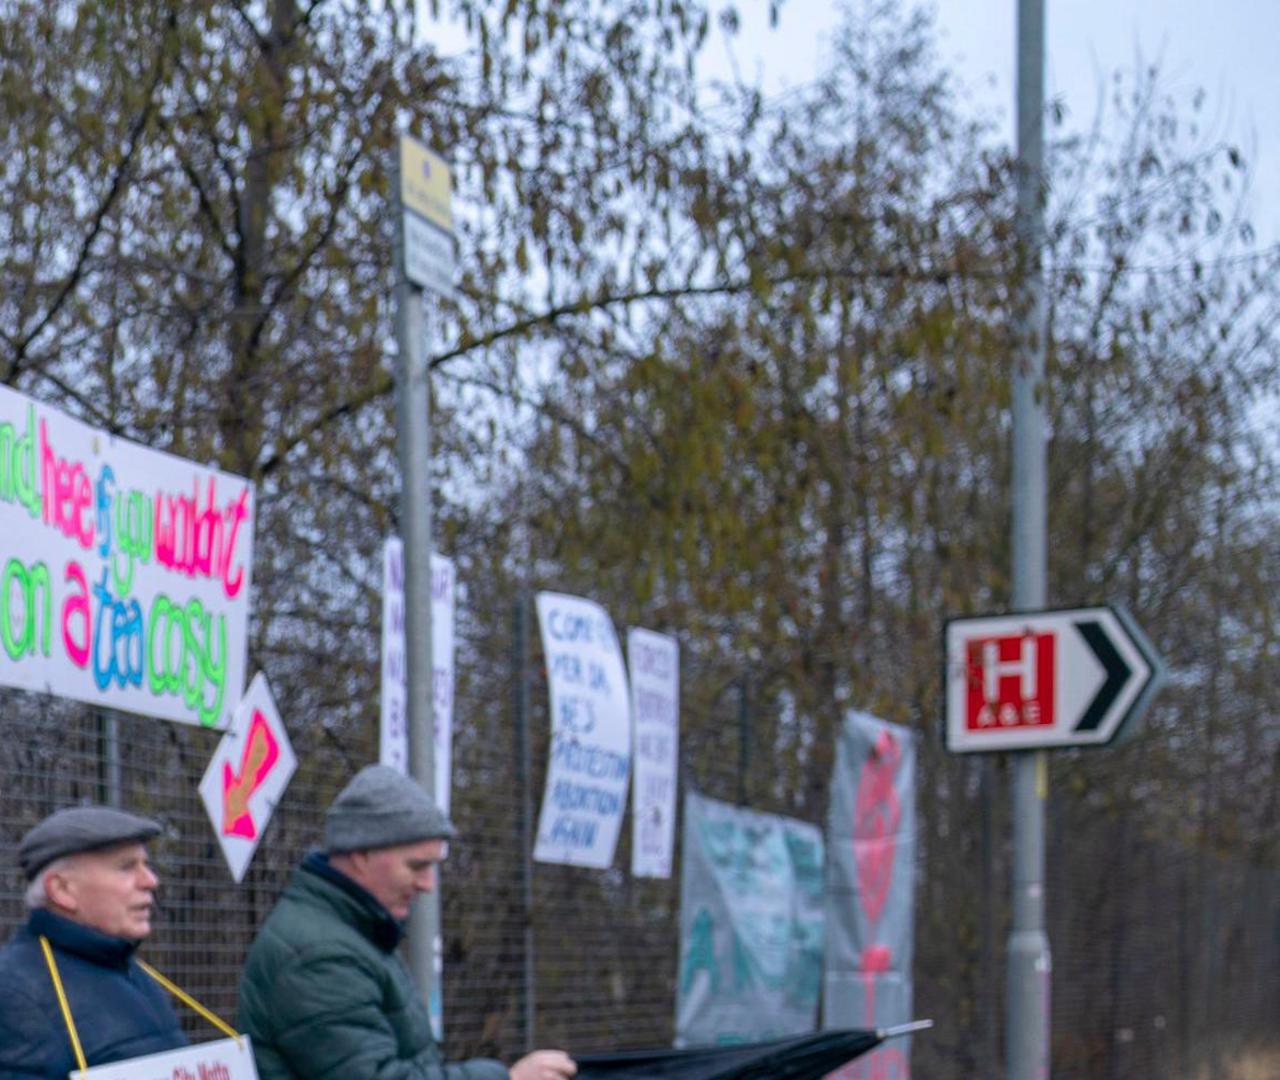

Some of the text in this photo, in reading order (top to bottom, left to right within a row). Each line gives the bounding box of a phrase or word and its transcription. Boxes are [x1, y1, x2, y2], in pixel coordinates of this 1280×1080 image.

[40, 416, 94, 550] here
[110, 489, 153, 597] you
[0, 556, 52, 661] on
[61, 559, 91, 670] a
[93, 565, 144, 691] tea
[147, 593, 228, 726] cosy
[983, 636, 1037, 702] H
[976, 701, 1041, 728] A&E
